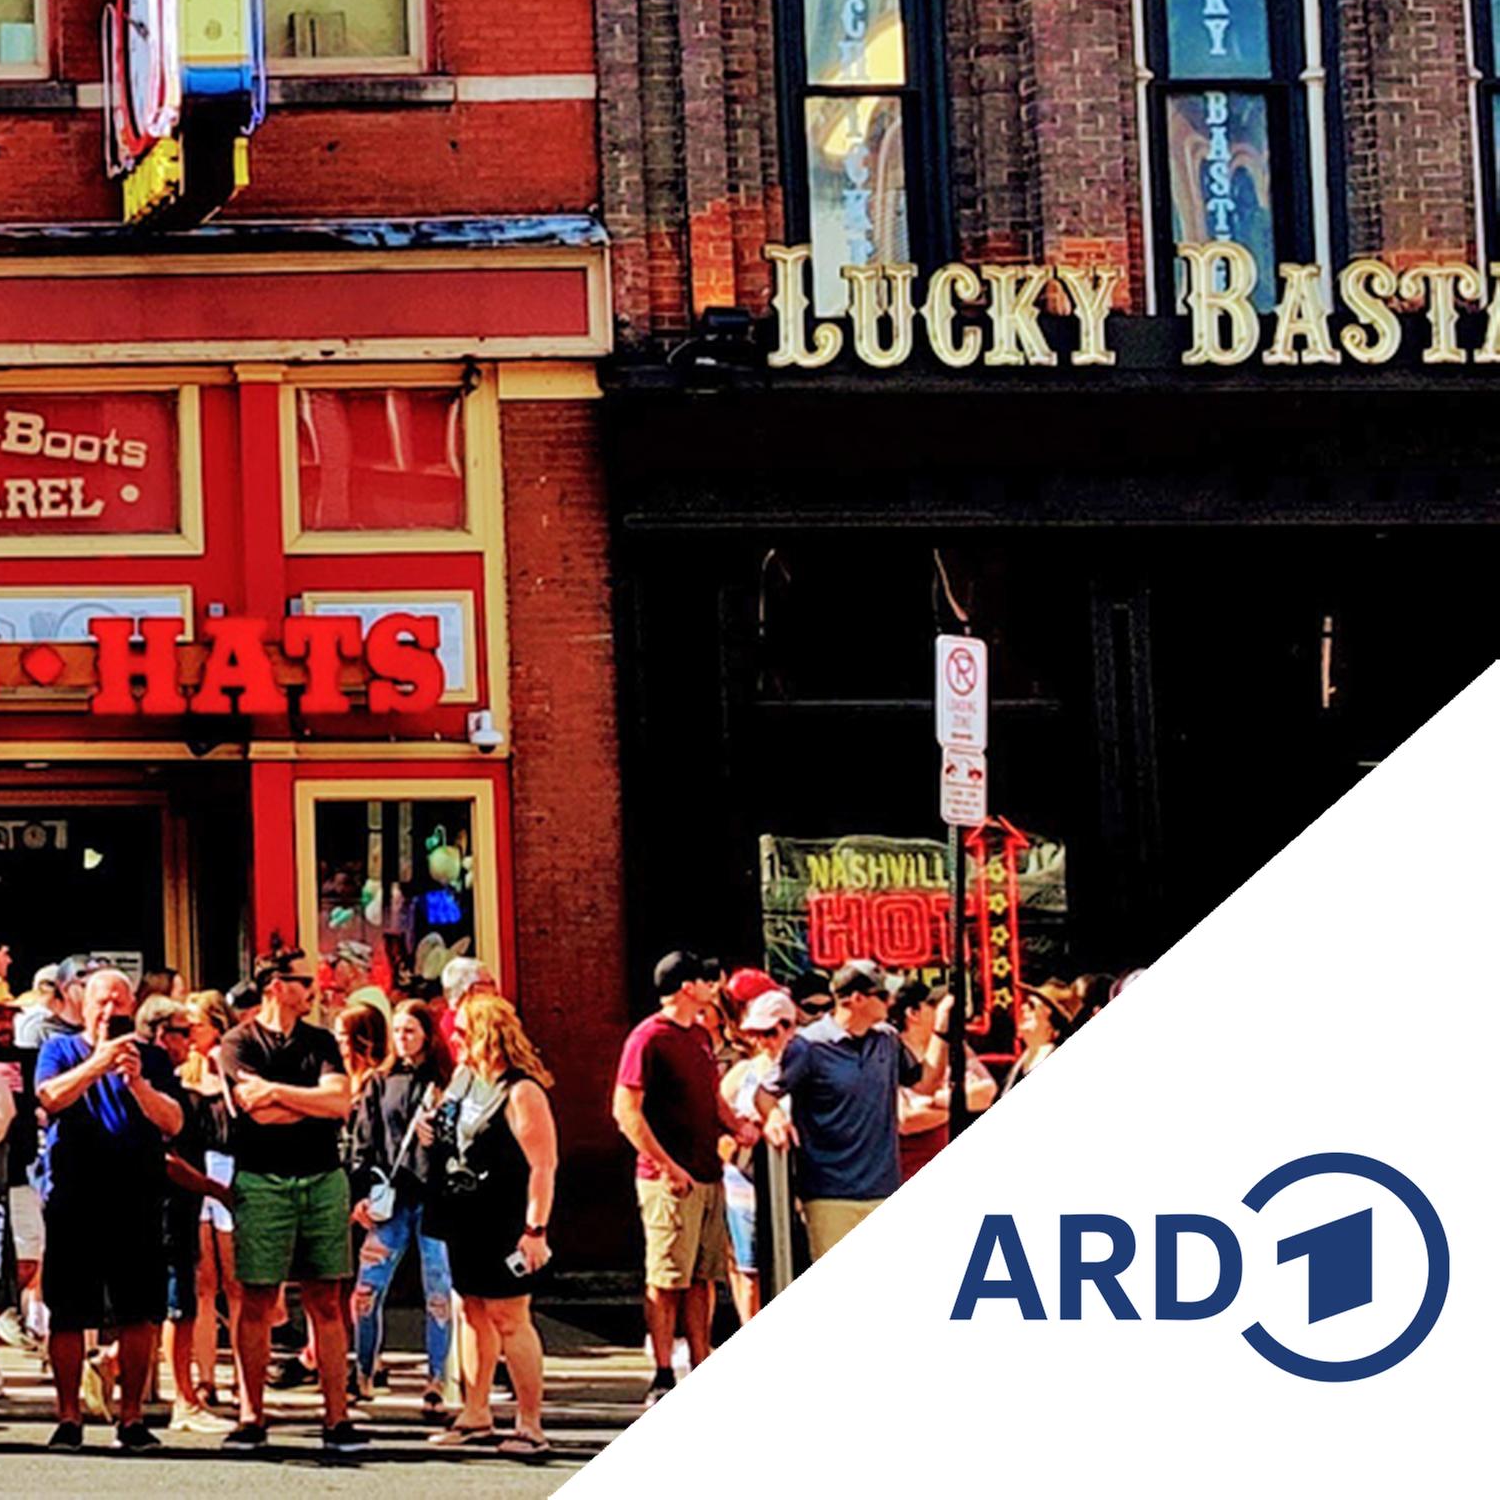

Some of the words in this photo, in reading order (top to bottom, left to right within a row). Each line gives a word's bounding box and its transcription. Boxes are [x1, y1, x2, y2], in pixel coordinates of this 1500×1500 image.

[764, 244, 1117, 368] LUCKY
[0, 409, 149, 468] Boots
[87, 611, 447, 716] HATS
[806, 851, 951, 889] NASHVILL
[809, 893, 975, 966] HOT
